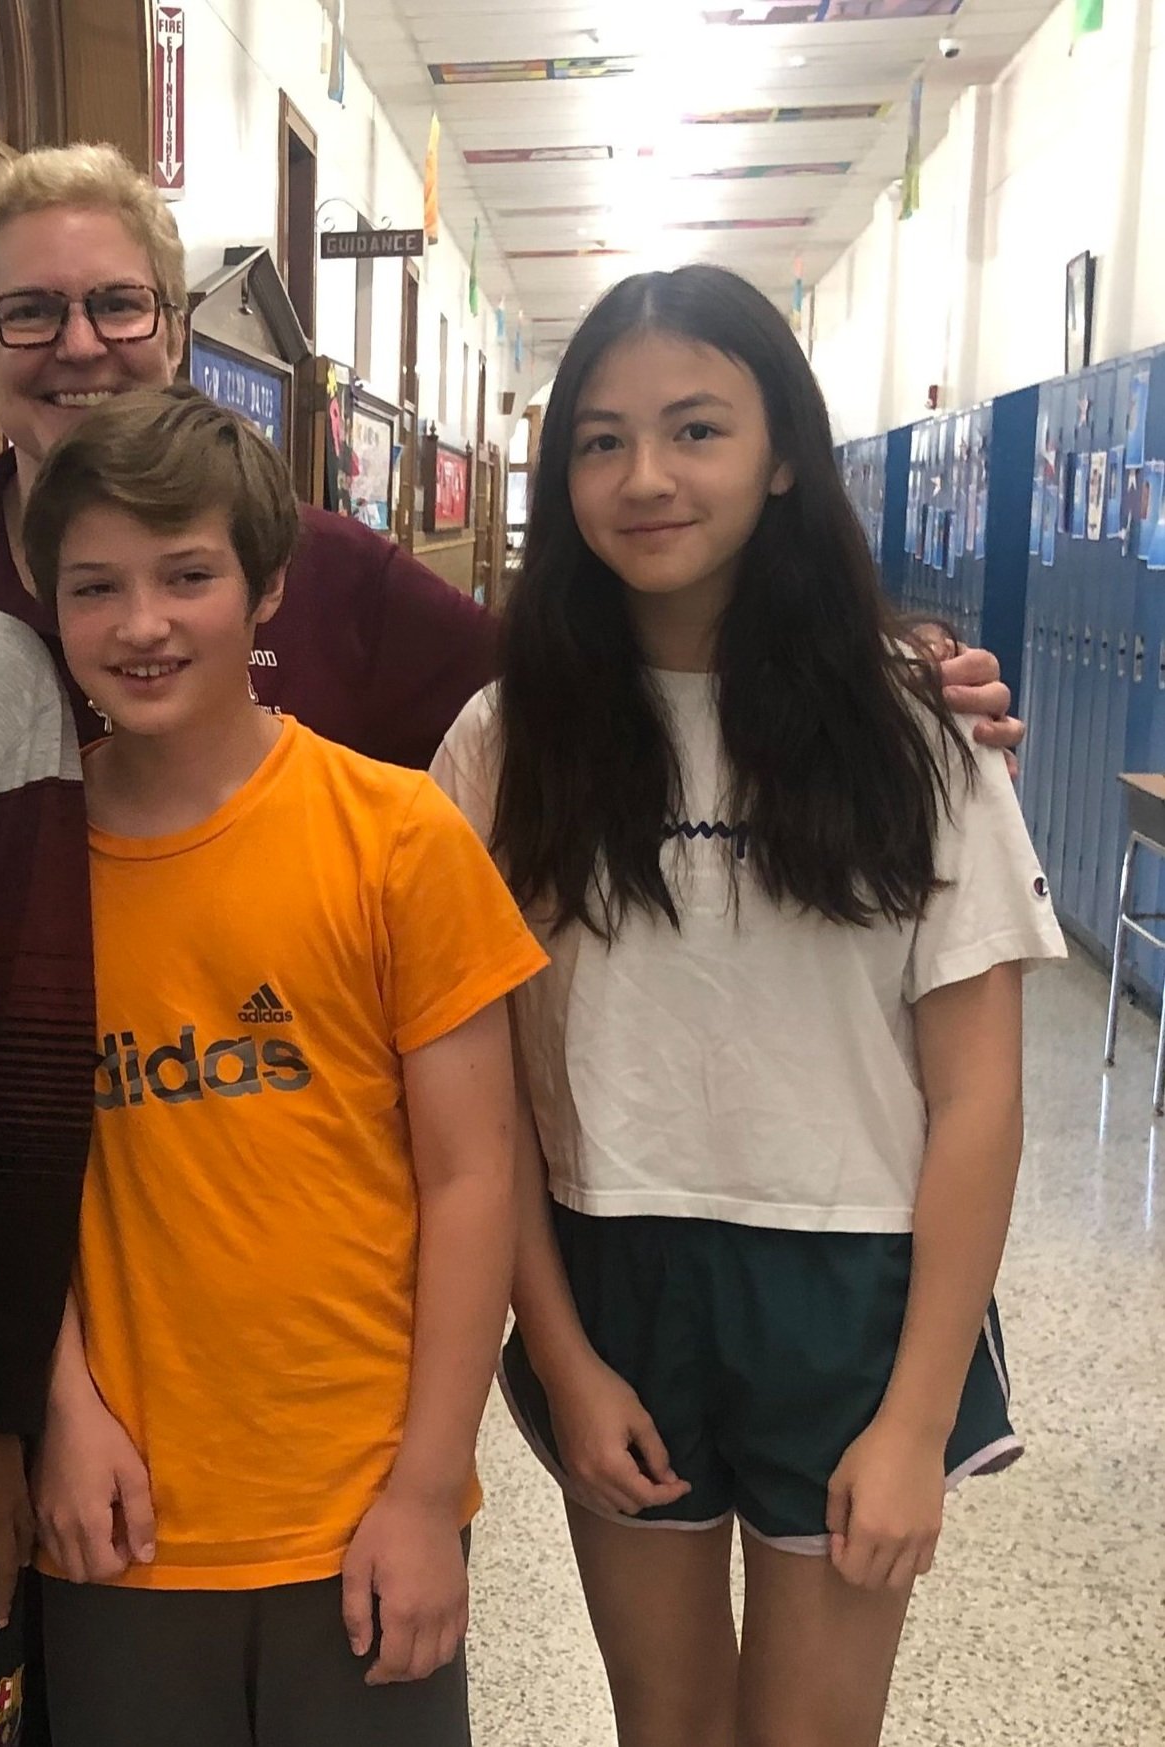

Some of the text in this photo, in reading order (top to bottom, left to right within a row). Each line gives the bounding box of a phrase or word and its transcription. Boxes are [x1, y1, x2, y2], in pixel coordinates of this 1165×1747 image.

[158, 19, 183, 34] FIRE
[326, 234, 417, 253] GUIDANCE
[237, 1007, 293, 1024] adidas
